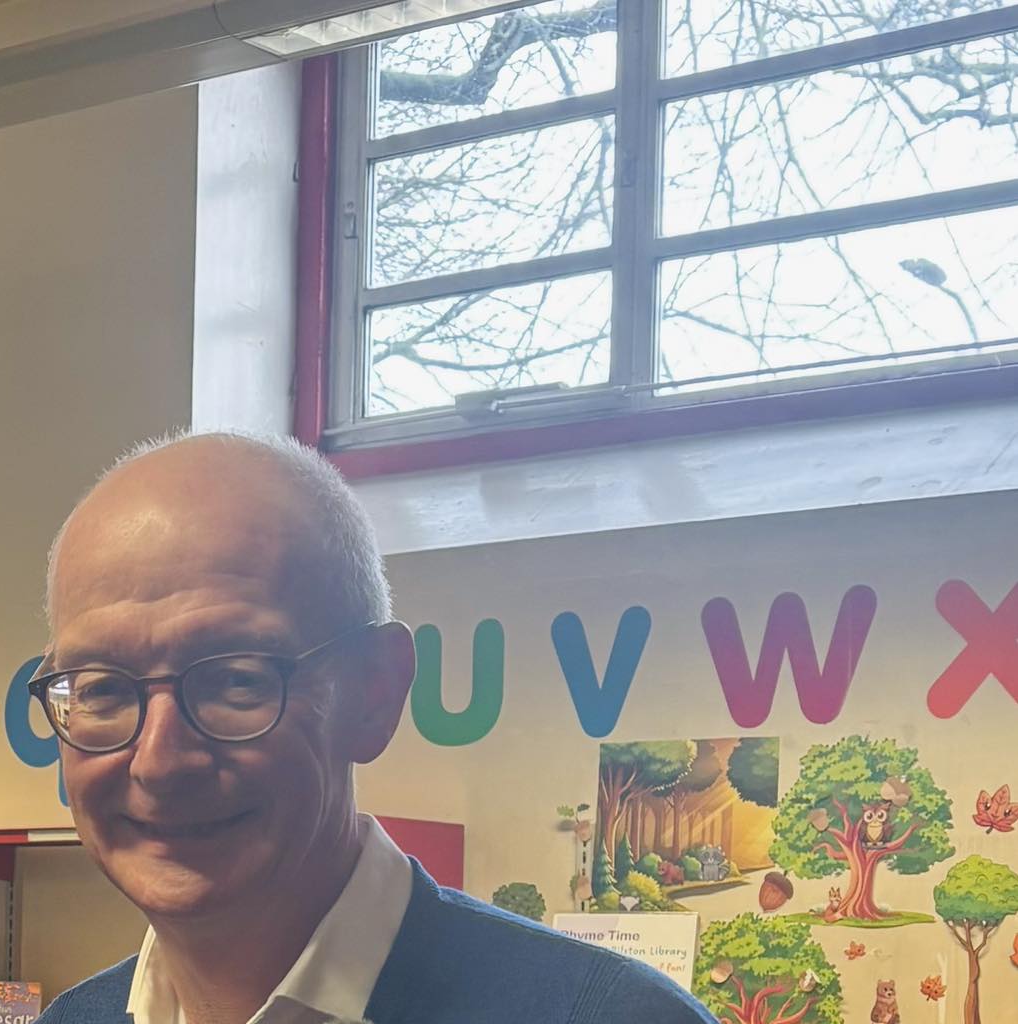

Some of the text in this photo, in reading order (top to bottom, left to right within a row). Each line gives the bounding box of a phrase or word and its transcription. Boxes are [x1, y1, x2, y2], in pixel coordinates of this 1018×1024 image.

[410, 618, 506, 747] u
[550, 605, 652, 739] v
[700, 584, 878, 729] w
[925, 578, 1018, 720] x
[608, 930, 640, 941] Time
[650, 945, 687, 960] Library
